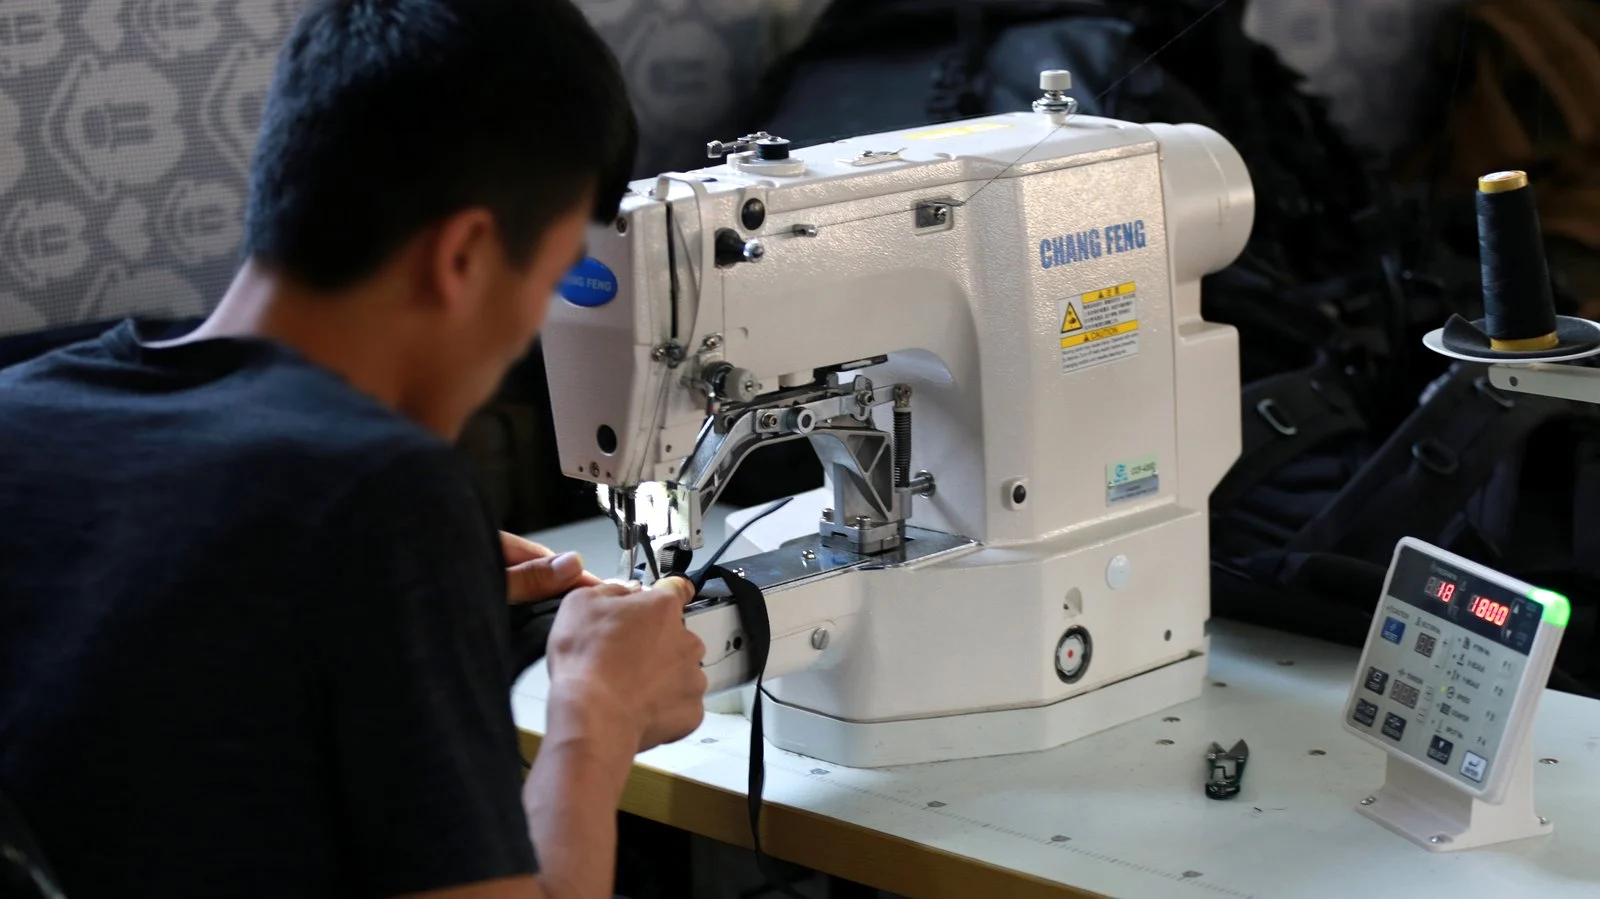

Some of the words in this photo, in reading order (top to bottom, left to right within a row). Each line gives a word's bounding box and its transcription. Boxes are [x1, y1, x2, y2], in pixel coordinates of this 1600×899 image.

[1041, 229, 1102, 269] CHANG
[1105, 220, 1146, 255] FENG
[586, 278, 612, 291] FENG
[1471, 596, 1511, 627] 1800
